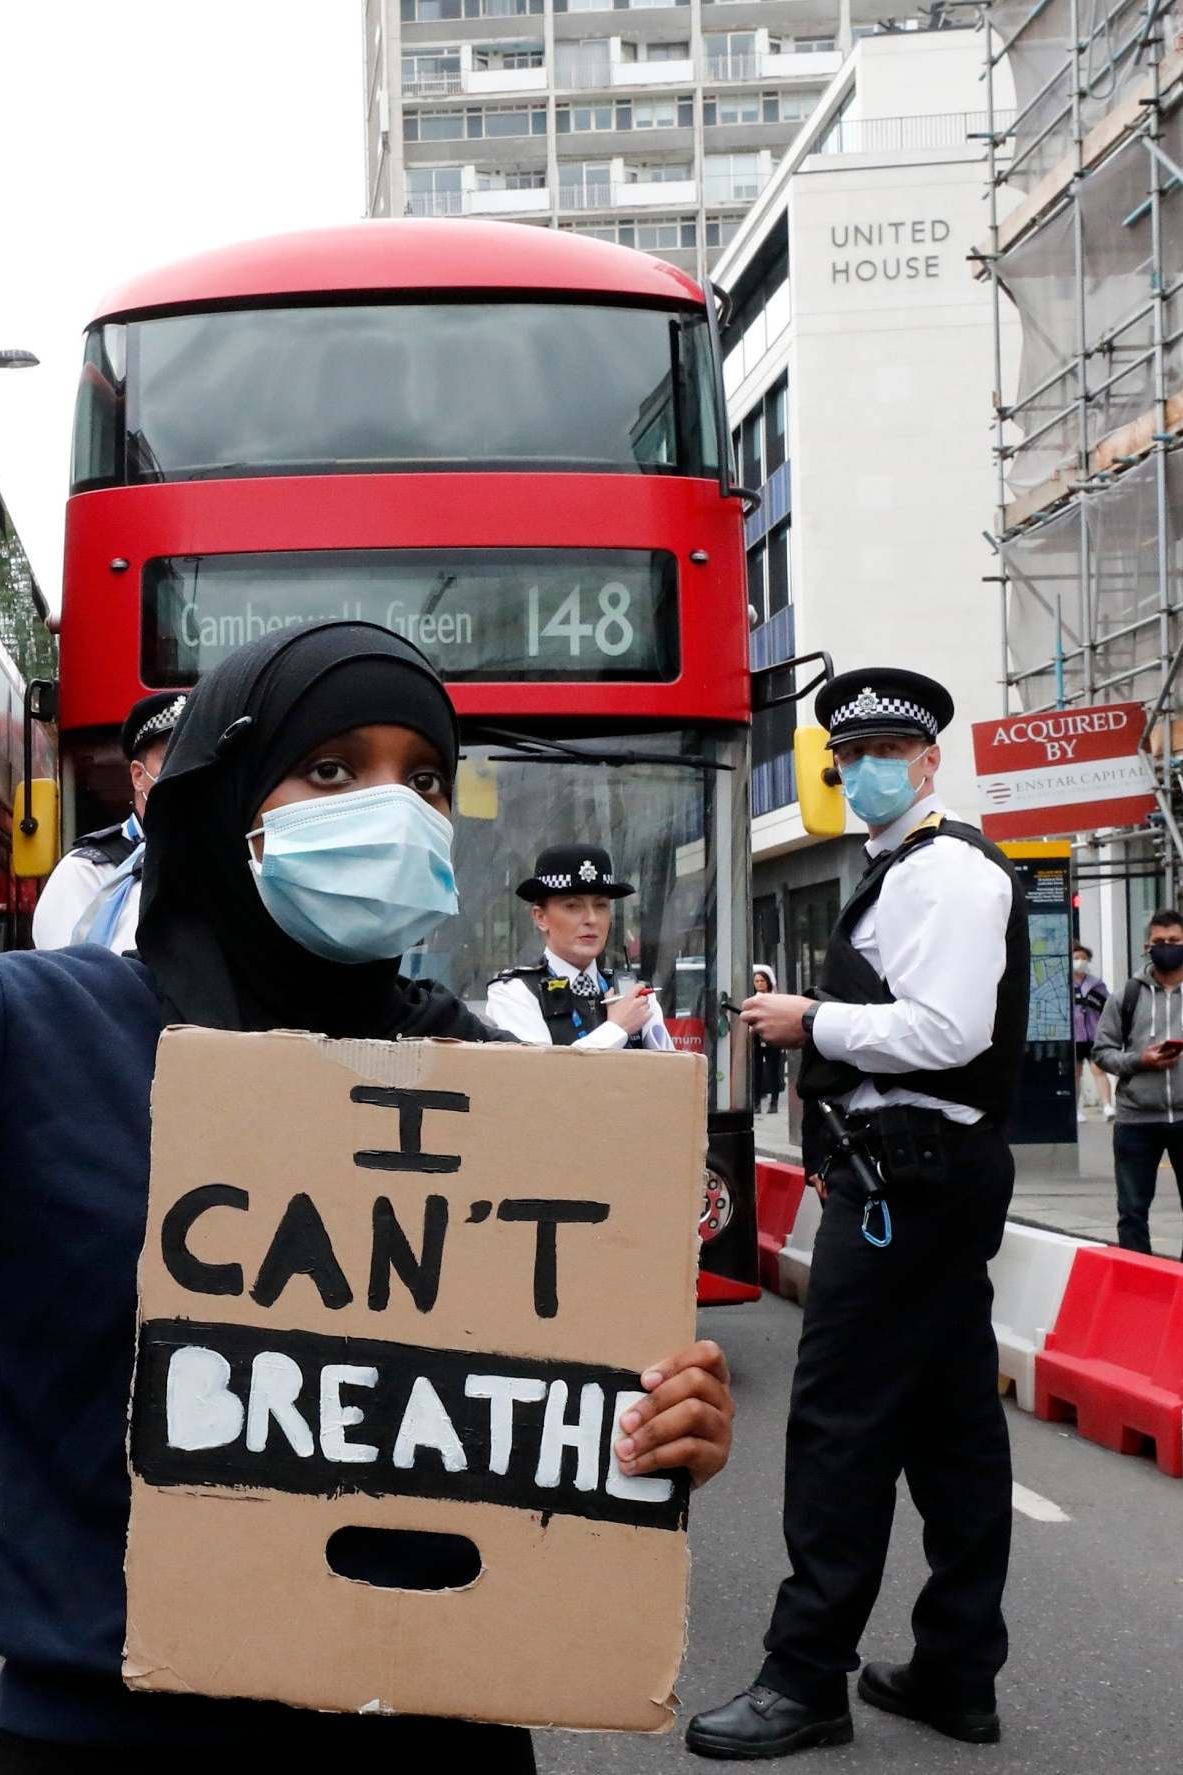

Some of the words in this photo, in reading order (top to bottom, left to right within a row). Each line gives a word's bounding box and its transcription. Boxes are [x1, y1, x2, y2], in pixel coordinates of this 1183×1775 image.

[831, 219, 951, 248] UNITED
[832, 255, 939, 284] HOUSE
[181, 601, 362, 646] Camber
[387, 600, 473, 644] Green
[529, 582, 634, 656] 148
[992, 711, 1128, 746] ACQUIRED
[1045, 739, 1077, 761] BY
[1016, 776, 1077, 793] ENSTAR
[1080, 766, 1149, 784] CAPITAL
[350, 1085, 470, 1174] I
[161, 1183, 610, 1319] CAN'T
